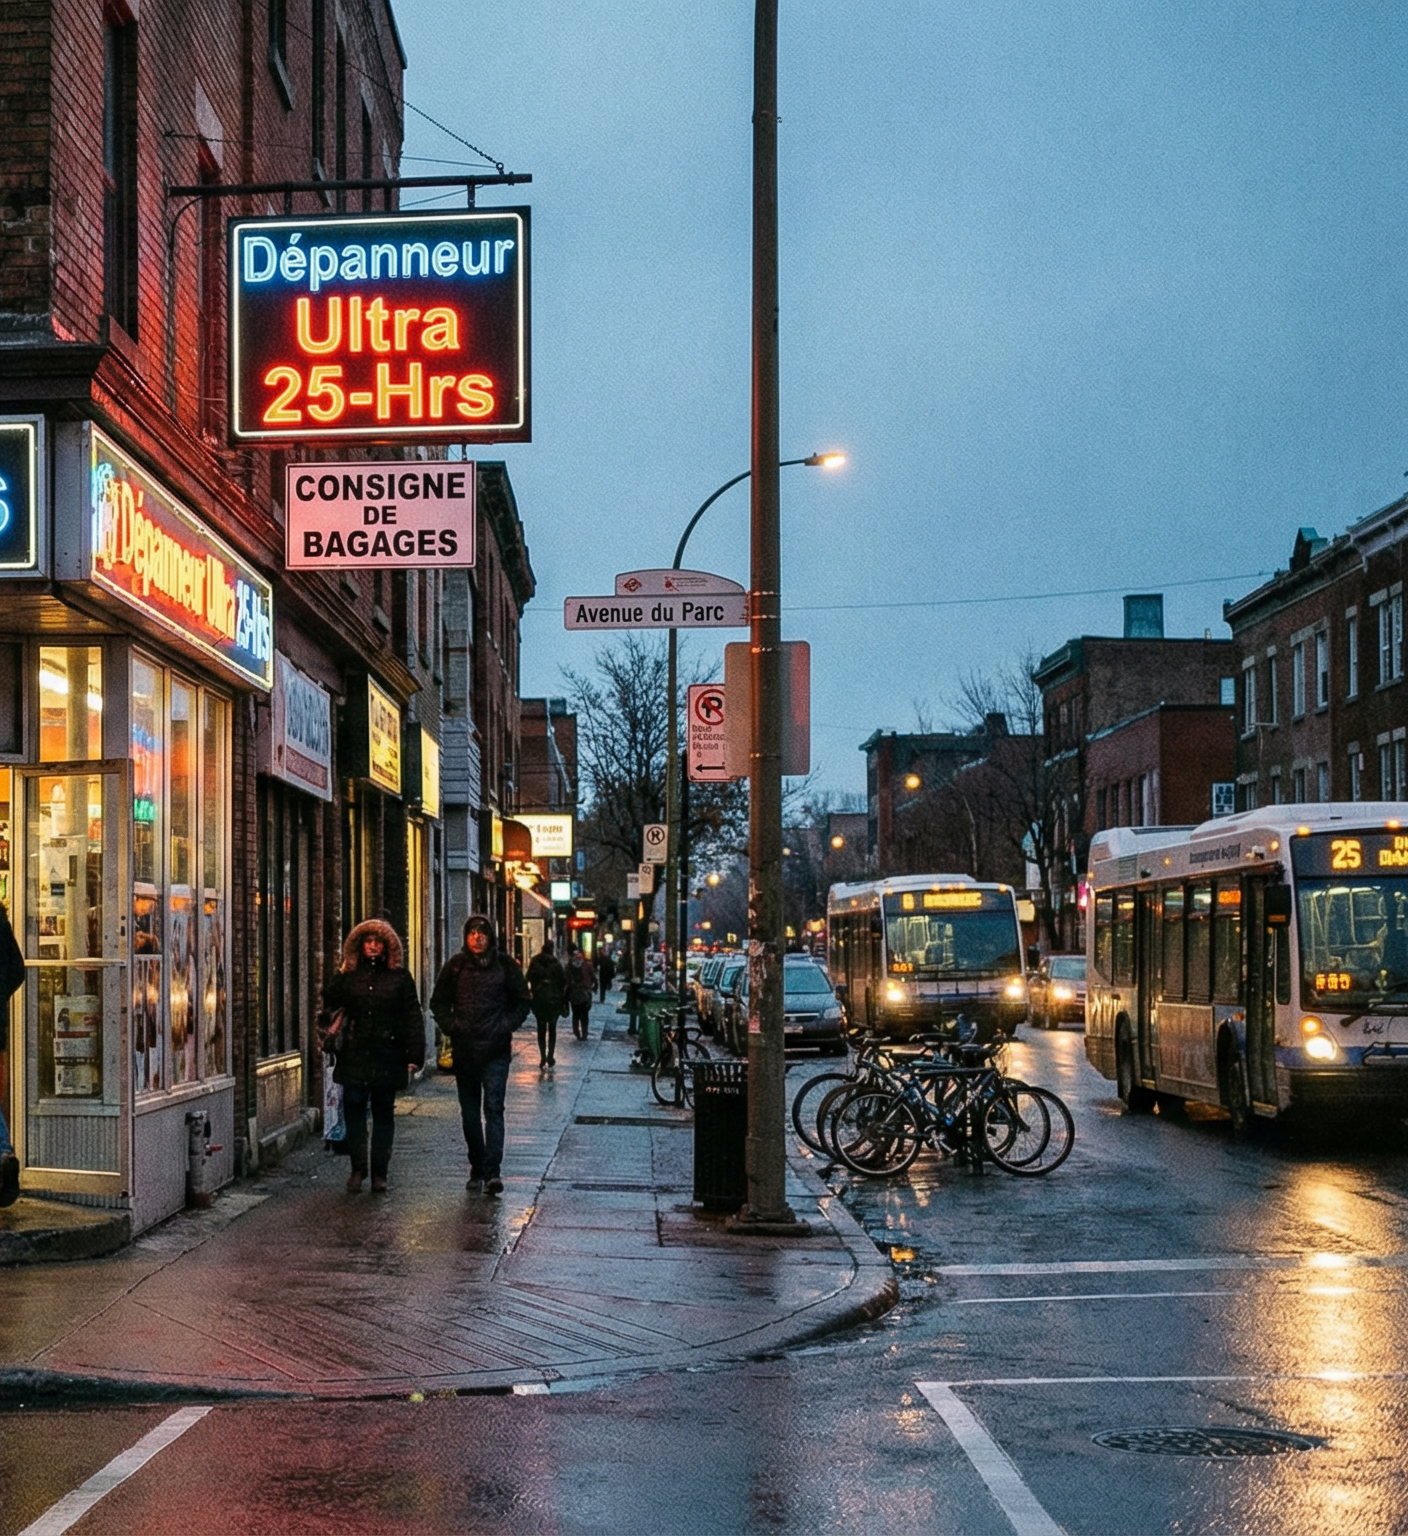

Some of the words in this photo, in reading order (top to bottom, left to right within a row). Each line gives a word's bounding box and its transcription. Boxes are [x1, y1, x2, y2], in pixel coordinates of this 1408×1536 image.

[243, 232, 515, 292] Dépanneur
[296, 296, 460, 354] Ultra
[263, 362, 495, 423] 25-Hrs
[295, 472, 466, 502] CONSIGNE
[363, 505, 398, 526] DE
[303, 529, 459, 558] BAGAGES
[575, 604, 643, 623] Avenue
[651, 602, 674, 622] du
[682, 602, 725, 621] Parc
[1331, 839, 1362, 869] 25
